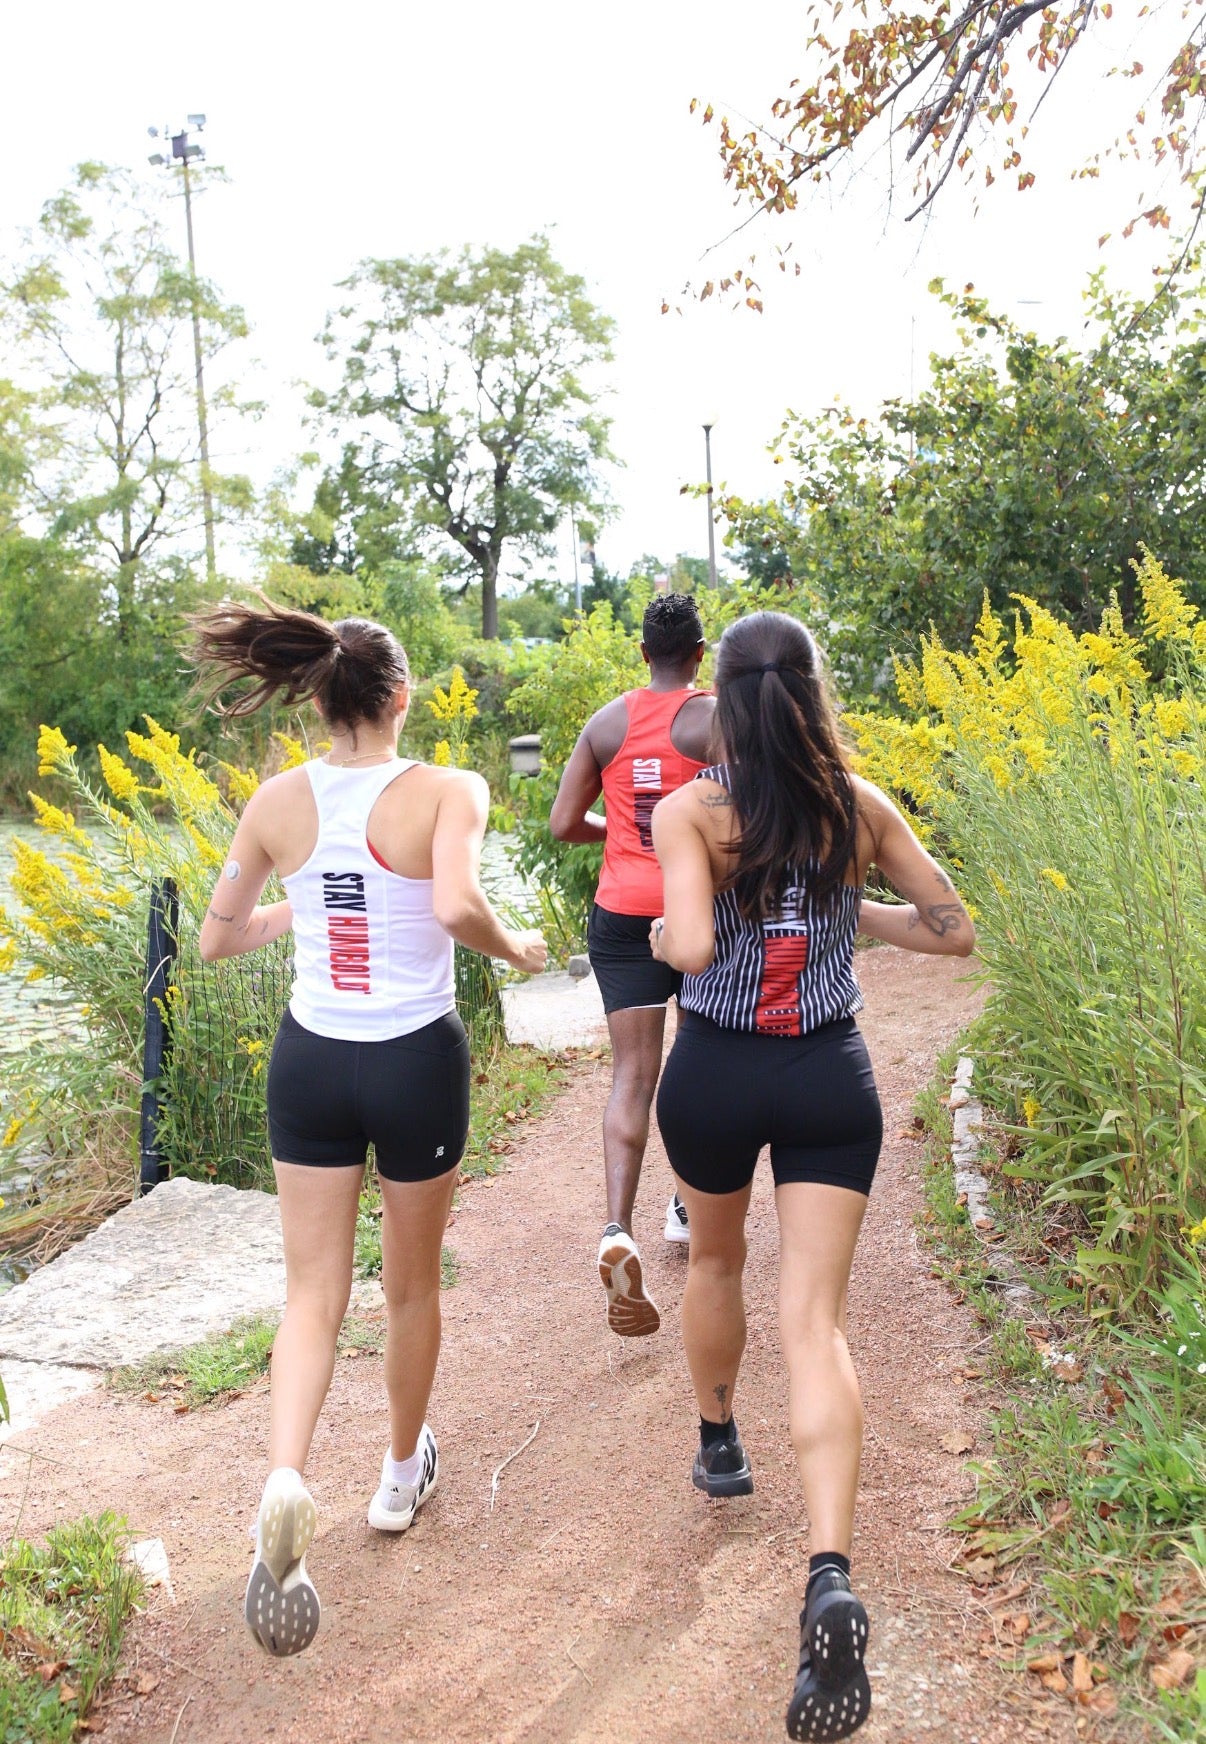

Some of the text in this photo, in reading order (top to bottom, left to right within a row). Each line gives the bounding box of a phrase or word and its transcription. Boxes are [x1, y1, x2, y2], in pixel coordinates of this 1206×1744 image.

[632, 758, 662, 789] STAY
[322, 872, 371, 994] STAY HUMBOLD
